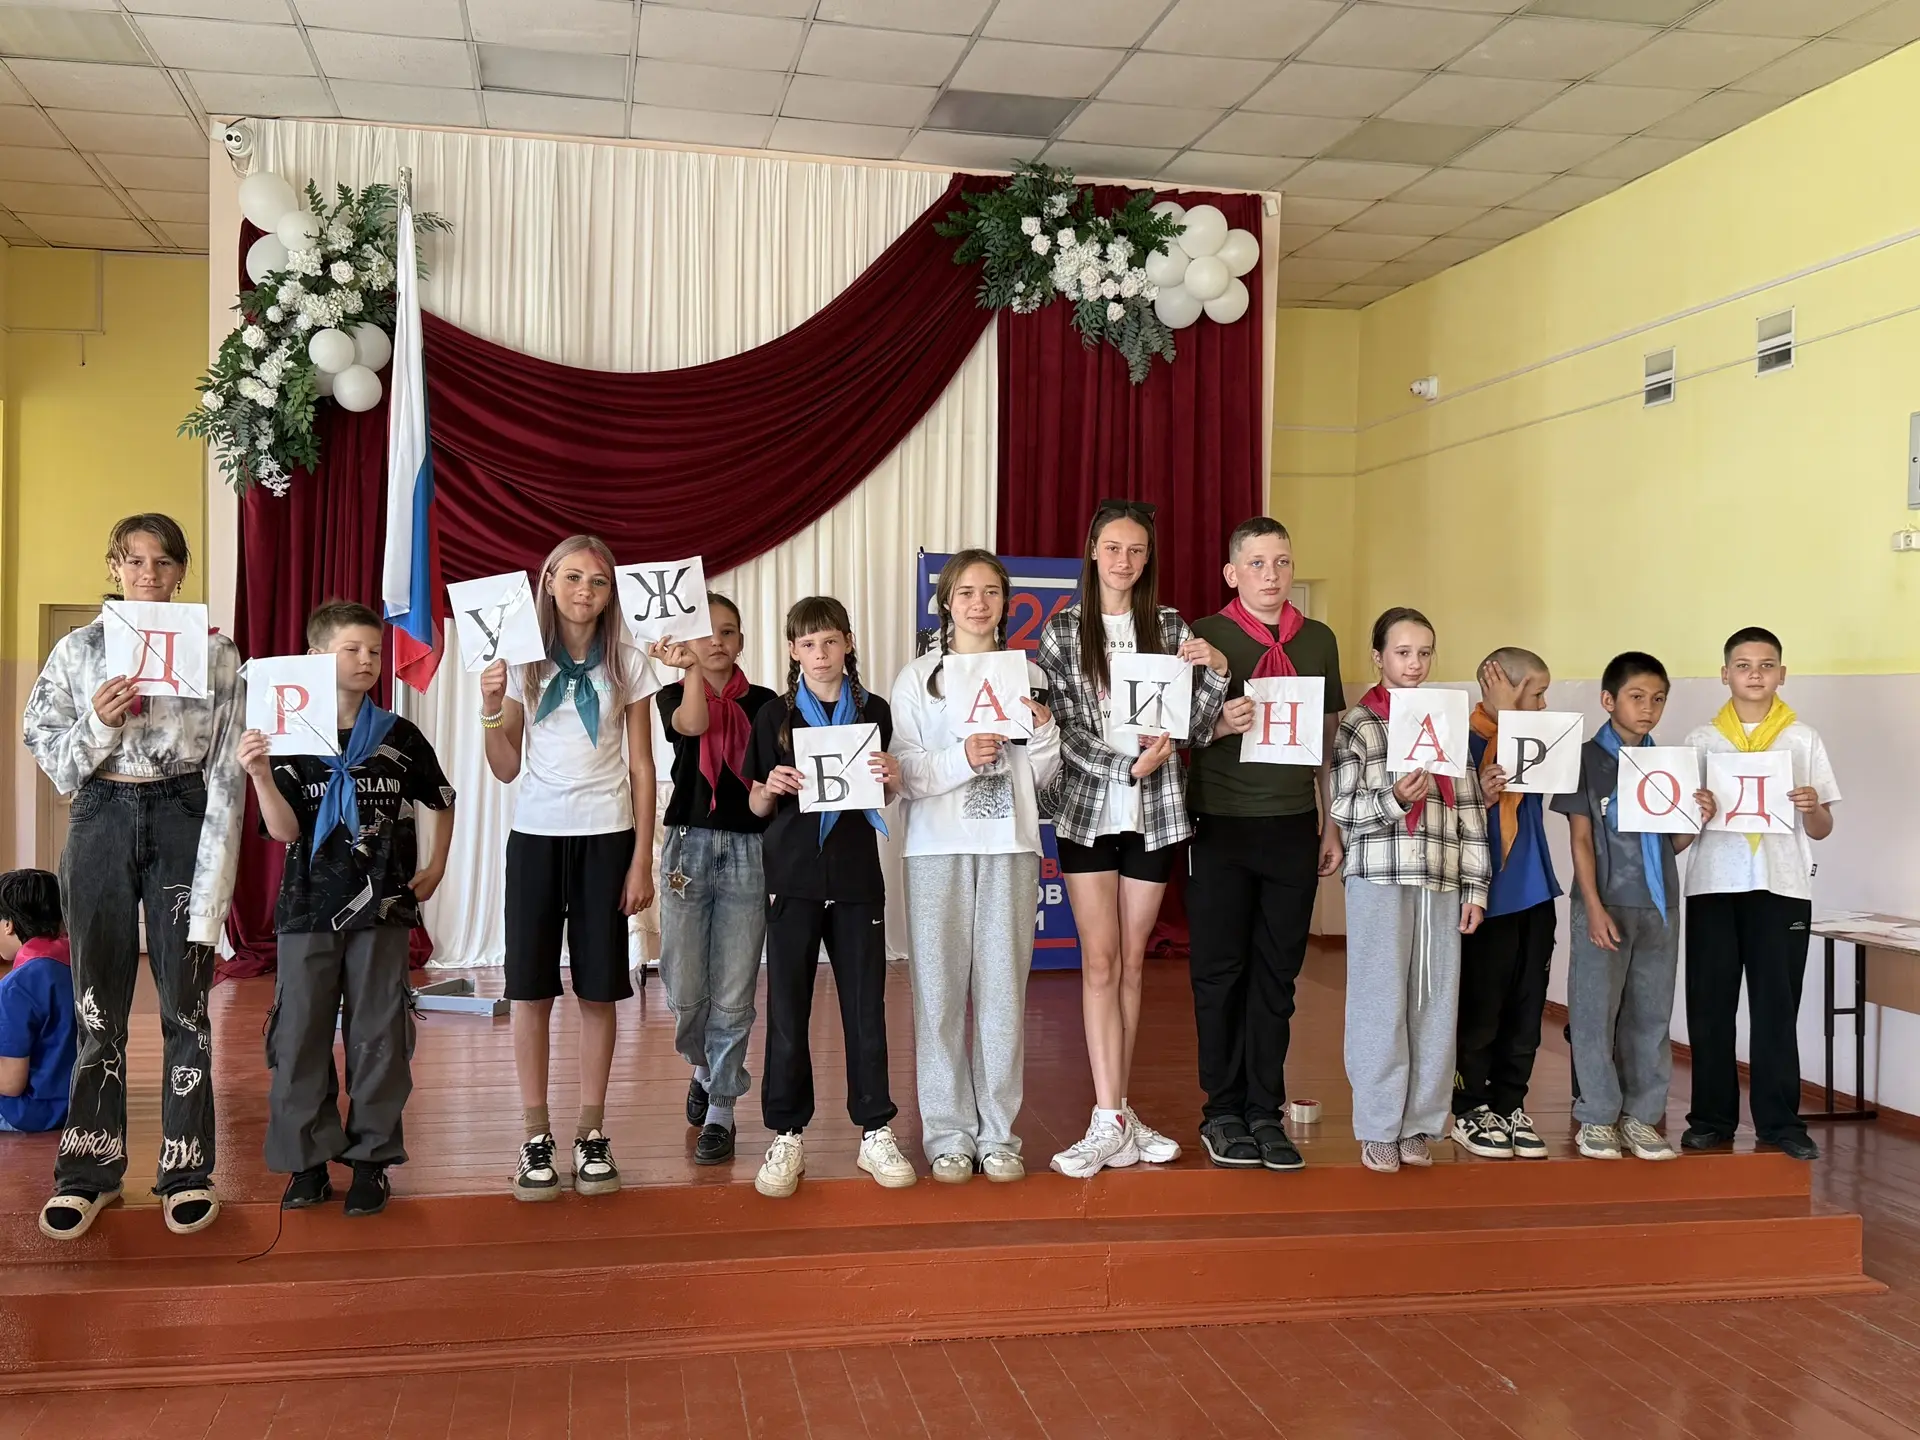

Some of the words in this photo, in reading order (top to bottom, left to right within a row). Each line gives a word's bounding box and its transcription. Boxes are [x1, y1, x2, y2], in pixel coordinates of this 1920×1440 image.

[626, 565, 697, 623] Ж
[465, 604, 510, 662] У
[127, 629, 182, 695] Д
[270, 684, 310, 736] Р
[964, 678, 1012, 724] А
[1123, 679, 1171, 730] И
[1256, 701, 1304, 747] Н
[1403, 713, 1450, 763] А
[1509, 737, 1548, 785] Р
[356, 777, 400, 794] SLAND
[808, 754, 850, 803] Б
[1636, 770, 1681, 816] О
[1725, 775, 1772, 828] Д
